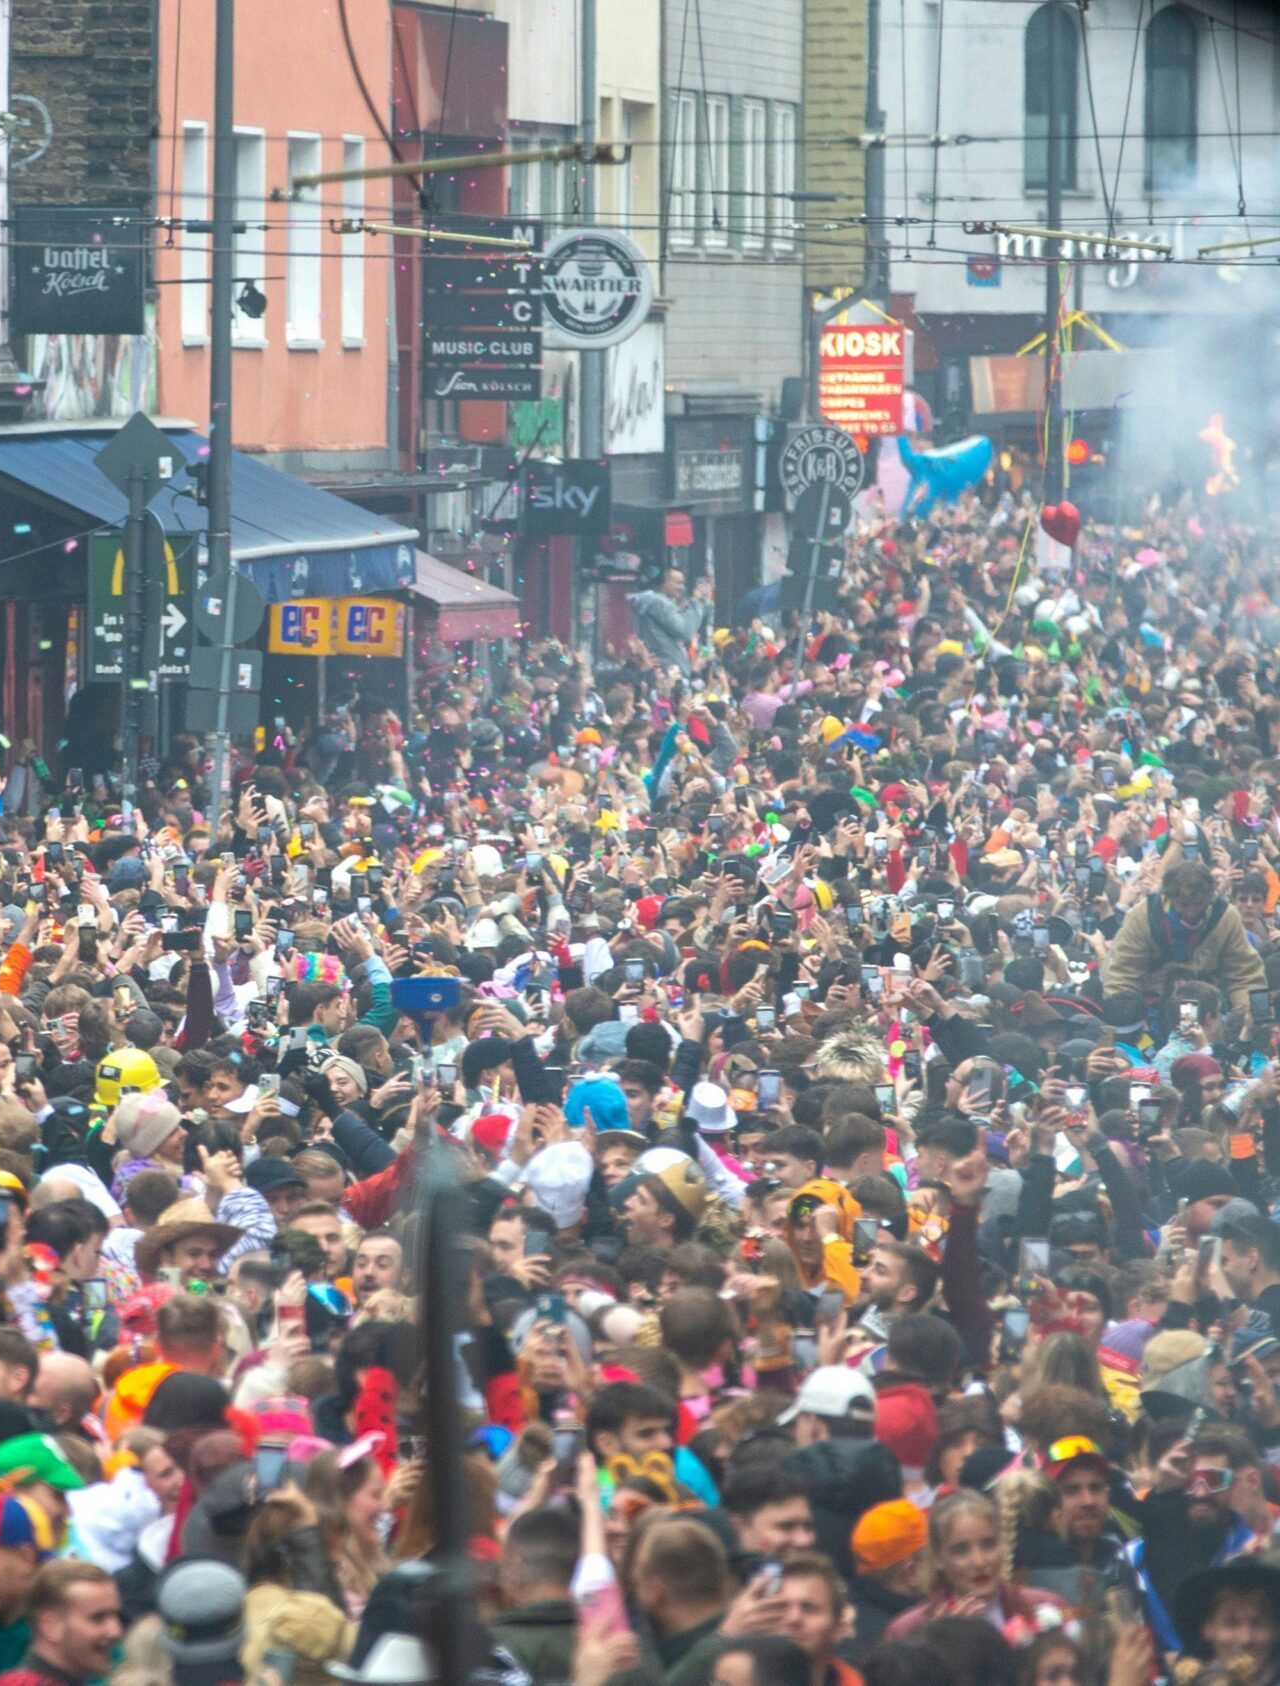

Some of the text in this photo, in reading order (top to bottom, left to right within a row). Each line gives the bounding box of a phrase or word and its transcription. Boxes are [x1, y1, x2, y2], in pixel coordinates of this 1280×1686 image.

[41, 270, 110, 296] Kölsch
[432, 341, 534, 356] MUSIC CLUB
[820, 331, 901, 357] KIOSK
[787, 429, 857, 460] FRISEUR
[533, 476, 600, 517] sky
